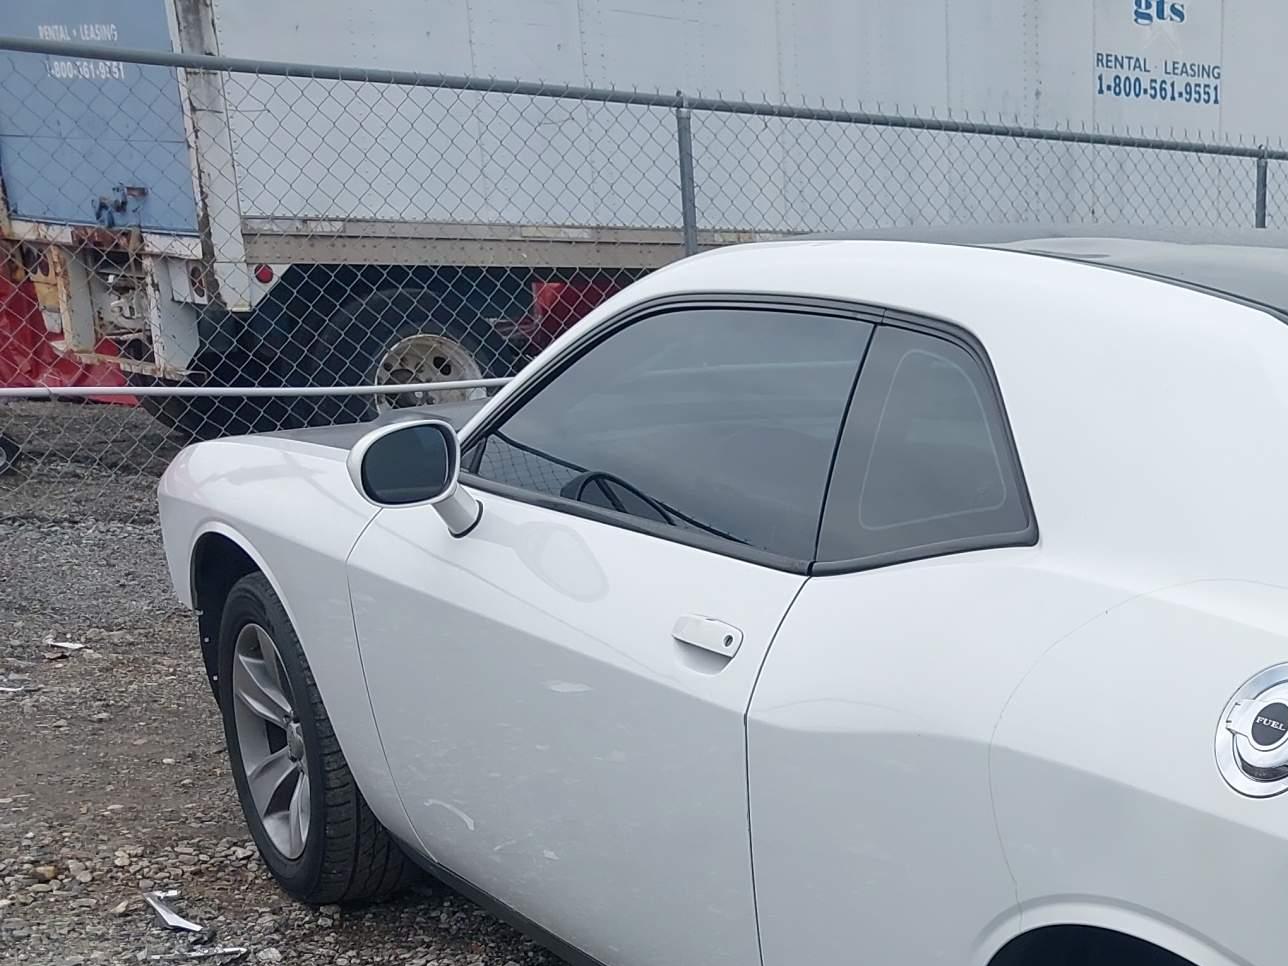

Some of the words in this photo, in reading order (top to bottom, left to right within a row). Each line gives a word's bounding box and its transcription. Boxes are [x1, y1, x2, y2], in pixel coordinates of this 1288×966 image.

[1134, 0, 1186, 26] gts
[80, 23, 119, 41] LEASING
[1096, 52, 1151, 73] RENTAL
[1164, 60, 1221, 80] LEASING
[1097, 74, 1219, 105] 1-800-561-9551
[1255, 715, 1286, 731] FUEL
